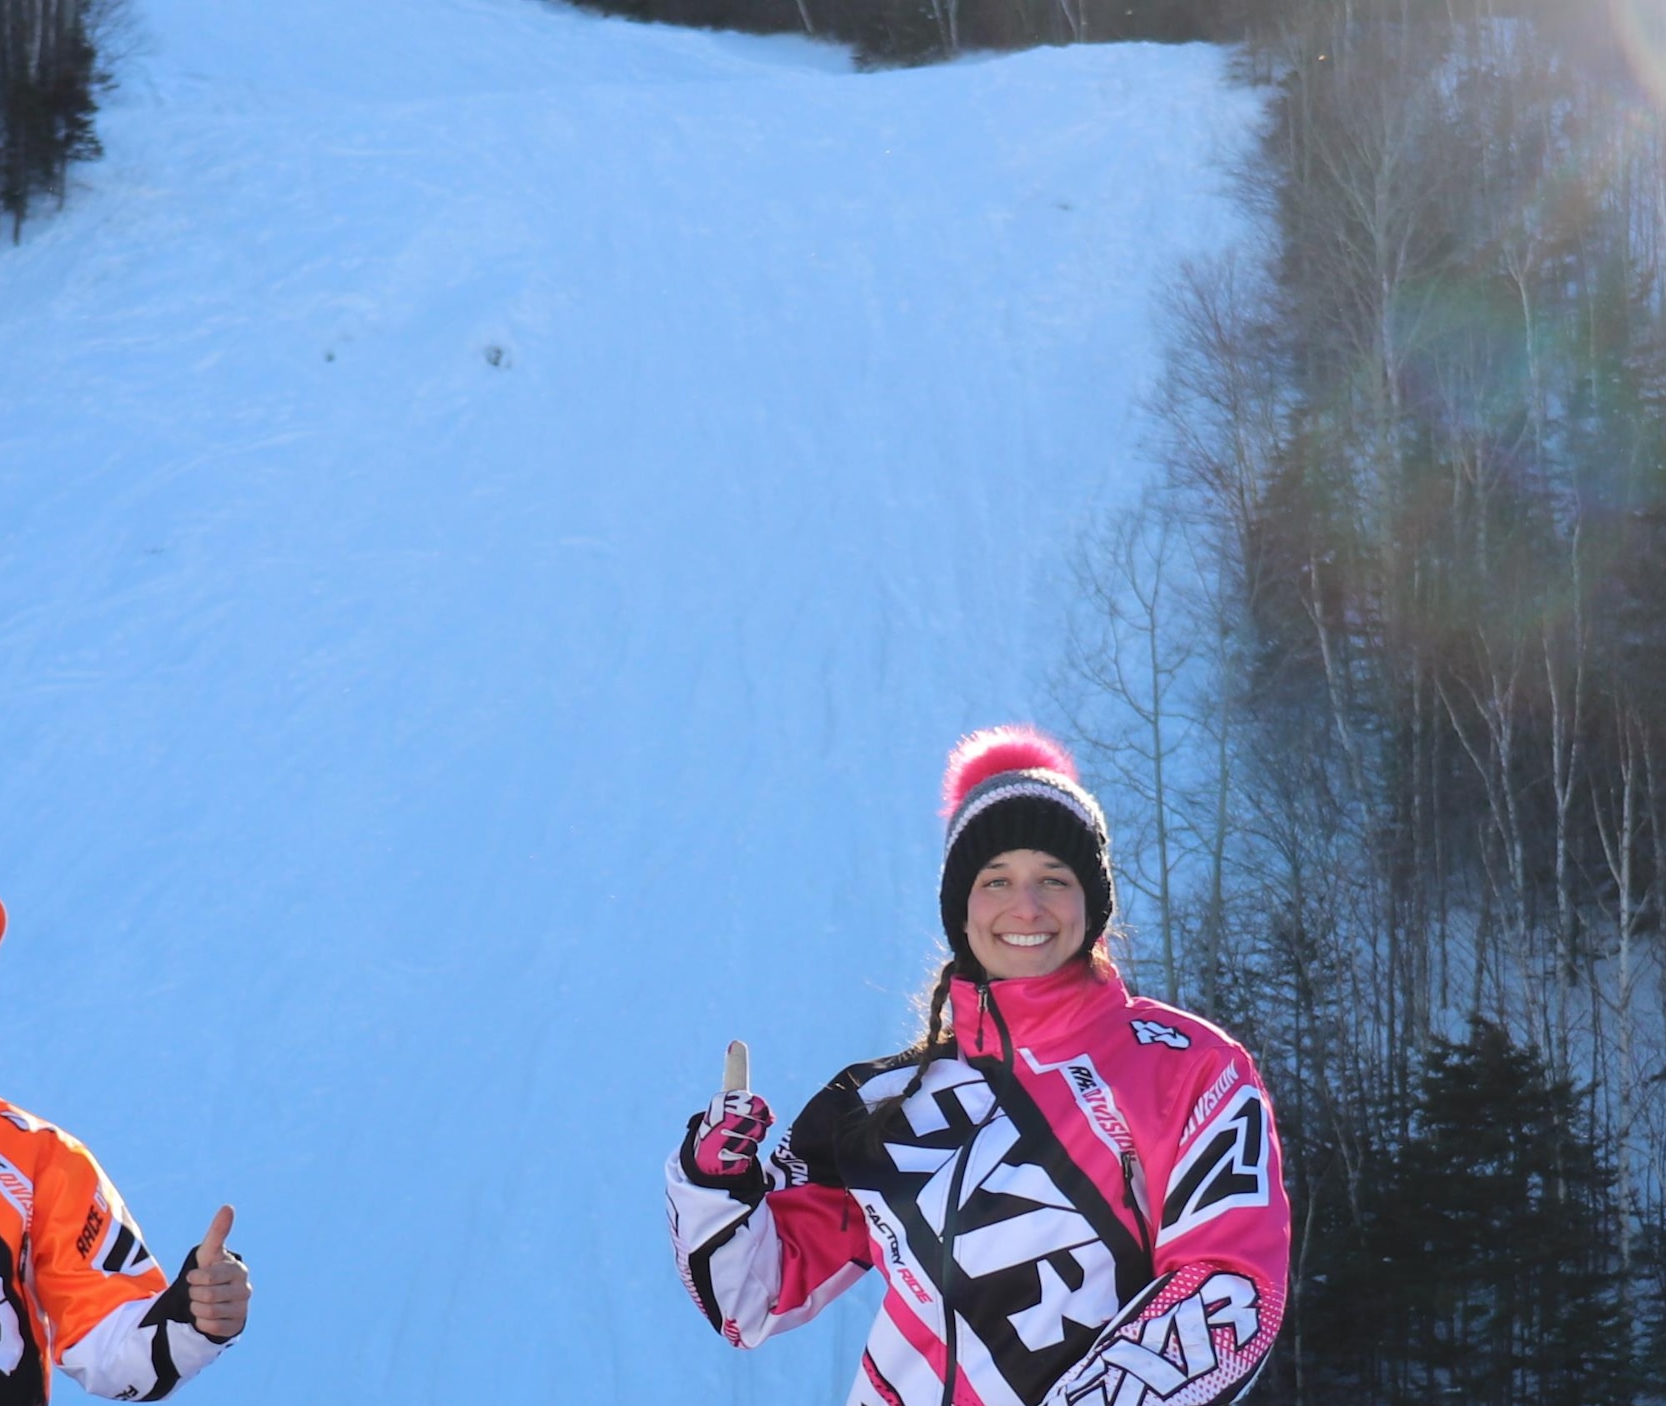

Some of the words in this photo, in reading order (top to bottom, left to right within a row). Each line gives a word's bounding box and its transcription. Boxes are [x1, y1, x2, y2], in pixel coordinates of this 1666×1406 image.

[76, 1205, 104, 1259] RACE
[857, 1057, 1119, 1352] FXR
[864, 1204, 904, 1266] FACTORY
[898, 1268, 933, 1304] RIDE
